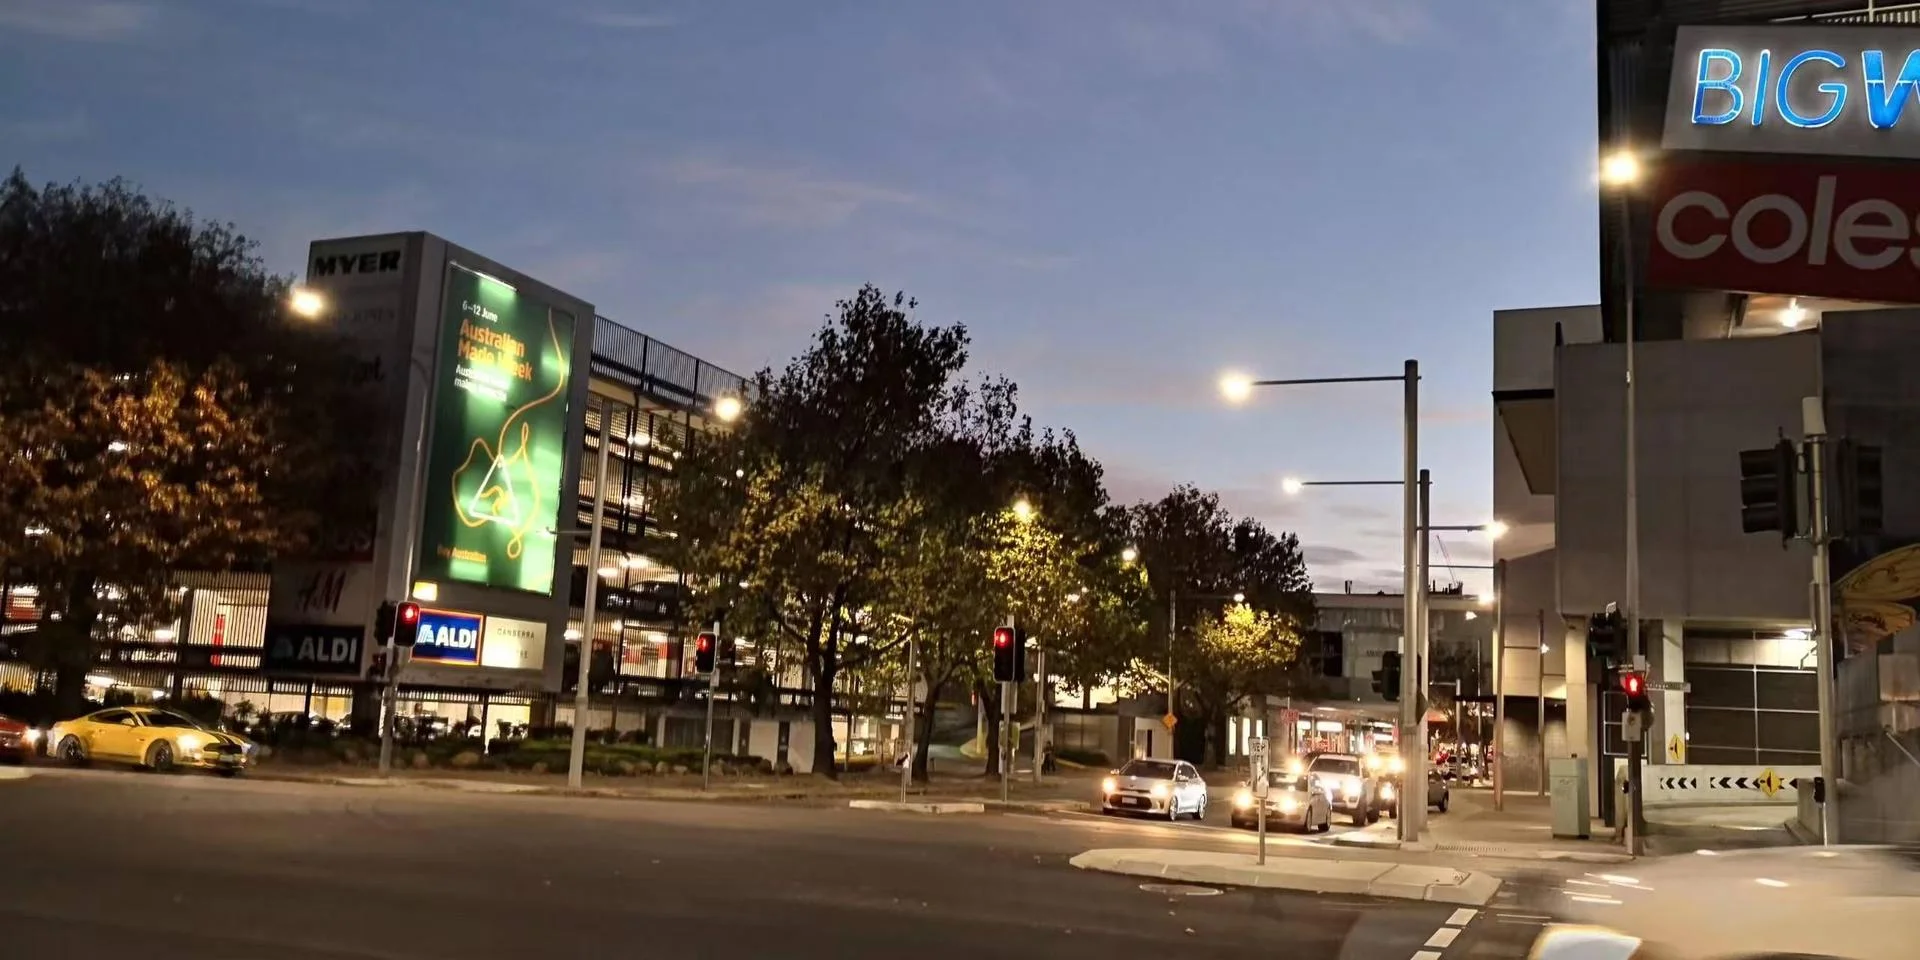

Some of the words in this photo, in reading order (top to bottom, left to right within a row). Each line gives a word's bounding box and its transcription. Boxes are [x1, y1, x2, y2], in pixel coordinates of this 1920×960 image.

[1656, 175, 1920, 270] cole
[314, 251, 401, 276] MYER
[481, 307, 498, 323] June
[460, 318, 525, 357] Australian
[458, 340, 494, 365] Made
[435, 626, 478, 649] ALDI
[496, 628, 535, 639] CANBERRA
[297, 637, 358, 663] ALDI
